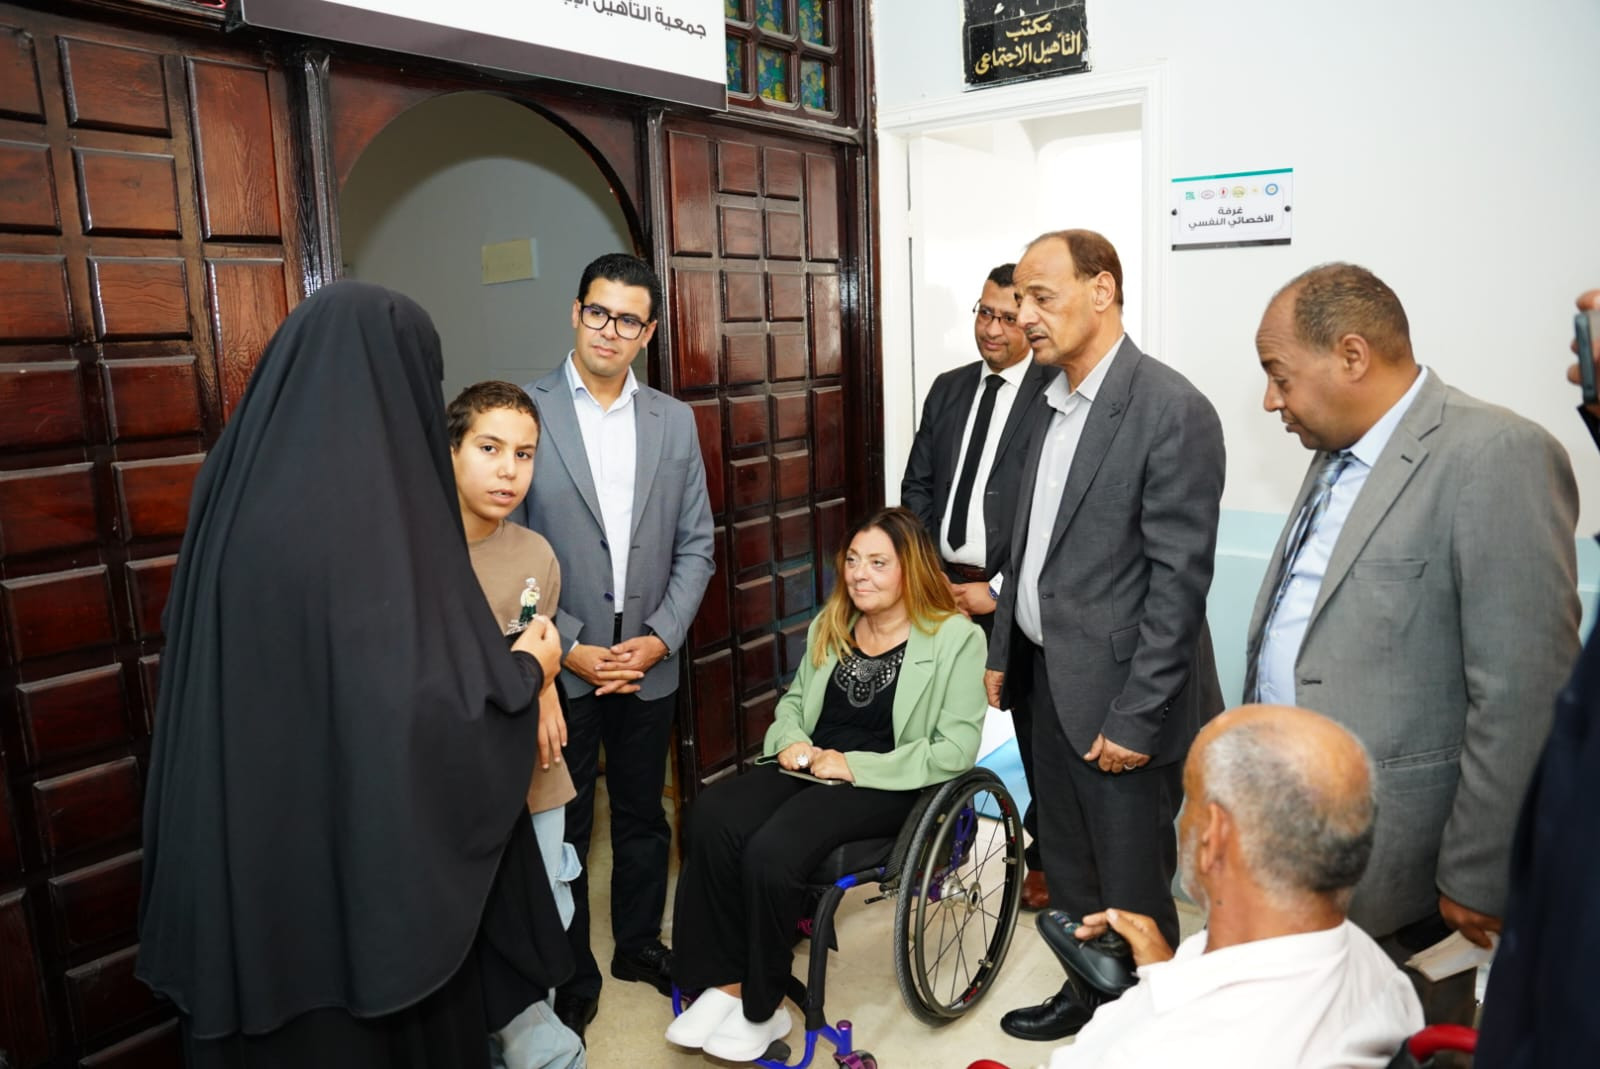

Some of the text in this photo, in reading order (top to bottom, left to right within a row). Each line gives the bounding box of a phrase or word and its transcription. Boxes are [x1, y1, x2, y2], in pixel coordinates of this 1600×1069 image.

[655, 6, 707, 39] جمعية
[1005, 13, 1053, 41] مكتب
[1033, 30, 1081, 64] التأهيل
[1188, 216, 1226, 231] النفسي
[1217, 206, 1243, 216] غرفة
